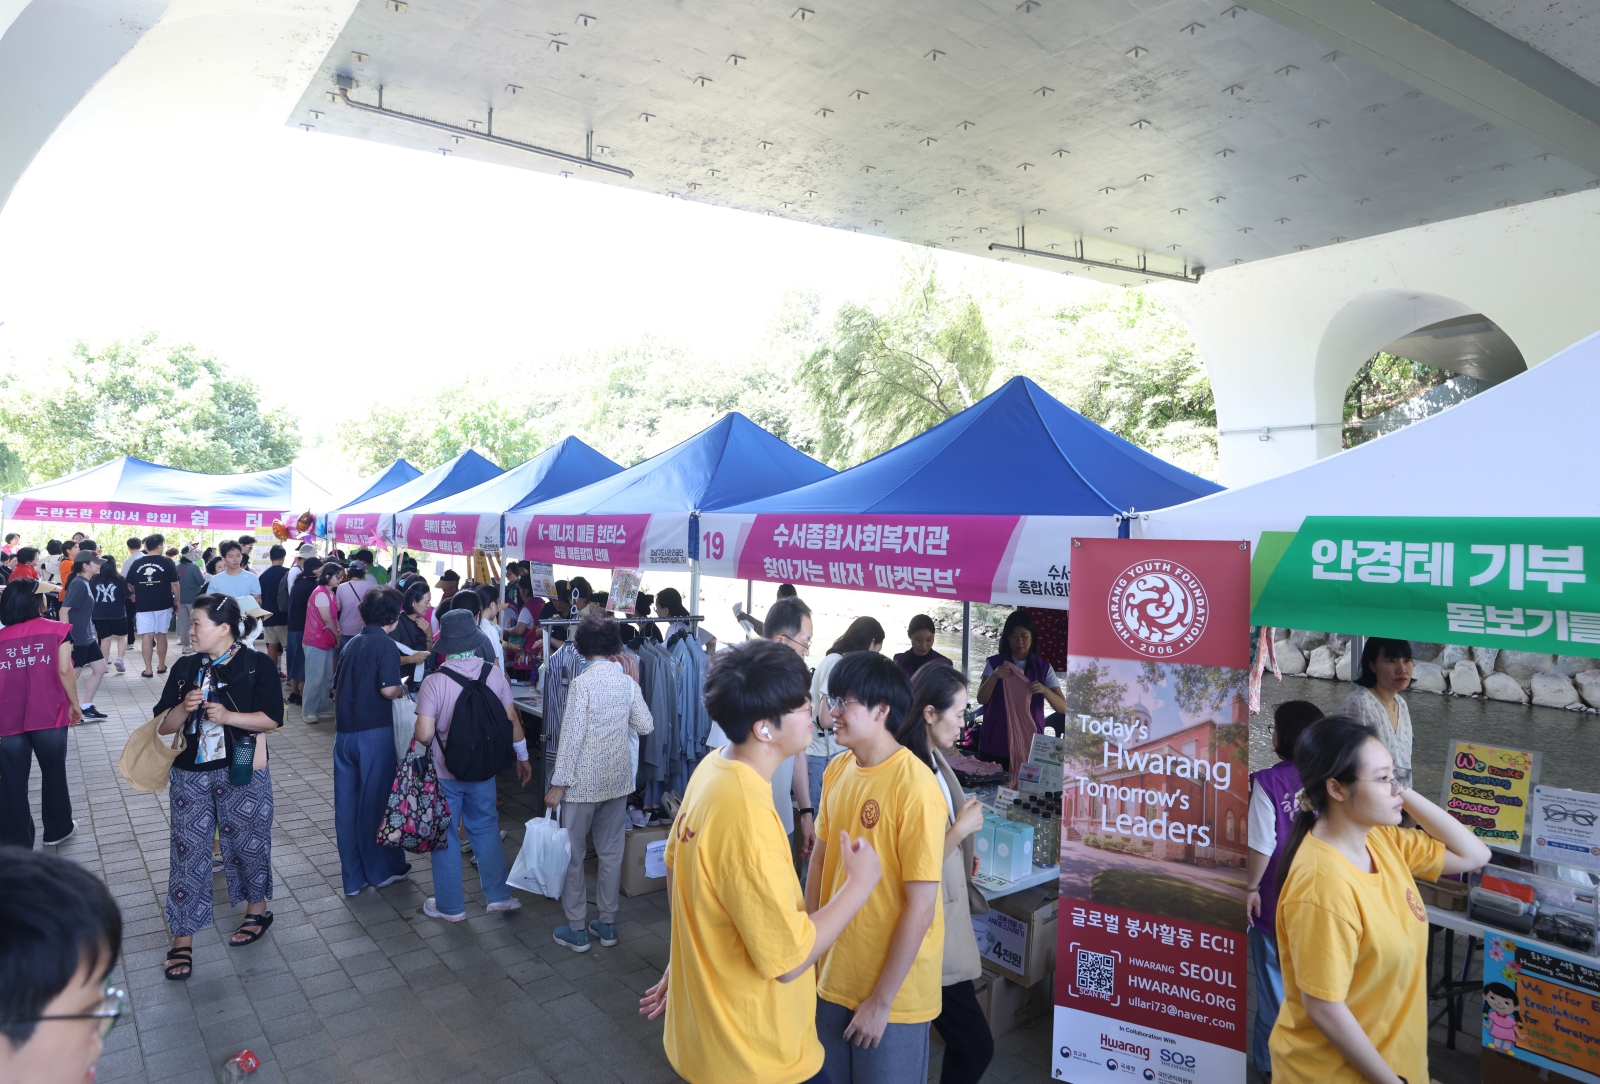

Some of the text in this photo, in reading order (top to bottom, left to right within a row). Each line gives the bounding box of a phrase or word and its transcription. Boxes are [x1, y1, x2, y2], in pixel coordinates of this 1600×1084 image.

[35, 506, 262, 527] 도란도란 앉아서 한입! 쉼 터
[506, 526, 518, 547] 20
[538, 524, 626, 544] K-매니저 매듭 헌터스
[703, 532, 724, 560] 19
[773, 523, 950, 556] 수서종합사회복지관
[554, 546, 566, 559] 전통
[594, 548, 610, 562] 판매
[1311, 539, 1586, 593] 안경테 기부
[763, 556, 961, 594] 찾아가는 바자 '마켓무브'
[1018, 580, 1070, 597] 종합사회
[96, 583, 117, 602] NY
[1111, 562, 1205, 644] HWARANG YOUTH FOUNDATION
[0, 655, 50, 670] 자원봉사
[6, 643, 44, 658] 강남구
[1140, 644, 1173, 654] 2006
[1078, 714, 1148, 742] Today's
[1103, 741, 1230, 790] Hwarang
[1455, 752, 1524, 780] We make
[1076, 776, 1189, 810] Tomorrow's
[1448, 797, 1500, 815] donated
[1451, 782, 1495, 800] glasses
[1495, 795, 1523, 807] with
[1102, 804, 1210, 847] Leaders
[1071, 907, 1234, 955] 글로벌 봉사활동 EC!!
[993, 941, 1021, 968] 4천원
[1530, 952, 1552, 964] 화랑
[1129, 957, 1237, 988] HWARANG SEOUL
[1520, 958, 1599, 988] Hwarang Seoul Youth
[1079, 988, 1111, 1001] SCAN ME
[1128, 975, 1236, 1011] HWARANG.ORG
[1521, 979, 1543, 995] We
[1552, 988, 1582, 1006] offer
[1128, 997, 1236, 1031] ullari73@naver.com
[1522, 1010, 1539, 1025] for
[1523, 995, 1590, 1026] translation
[1100, 1033, 1150, 1061] Hwarang
[1126, 1027, 1162, 1041] Collaboration
[1163, 1037, 1176, 1045] With
